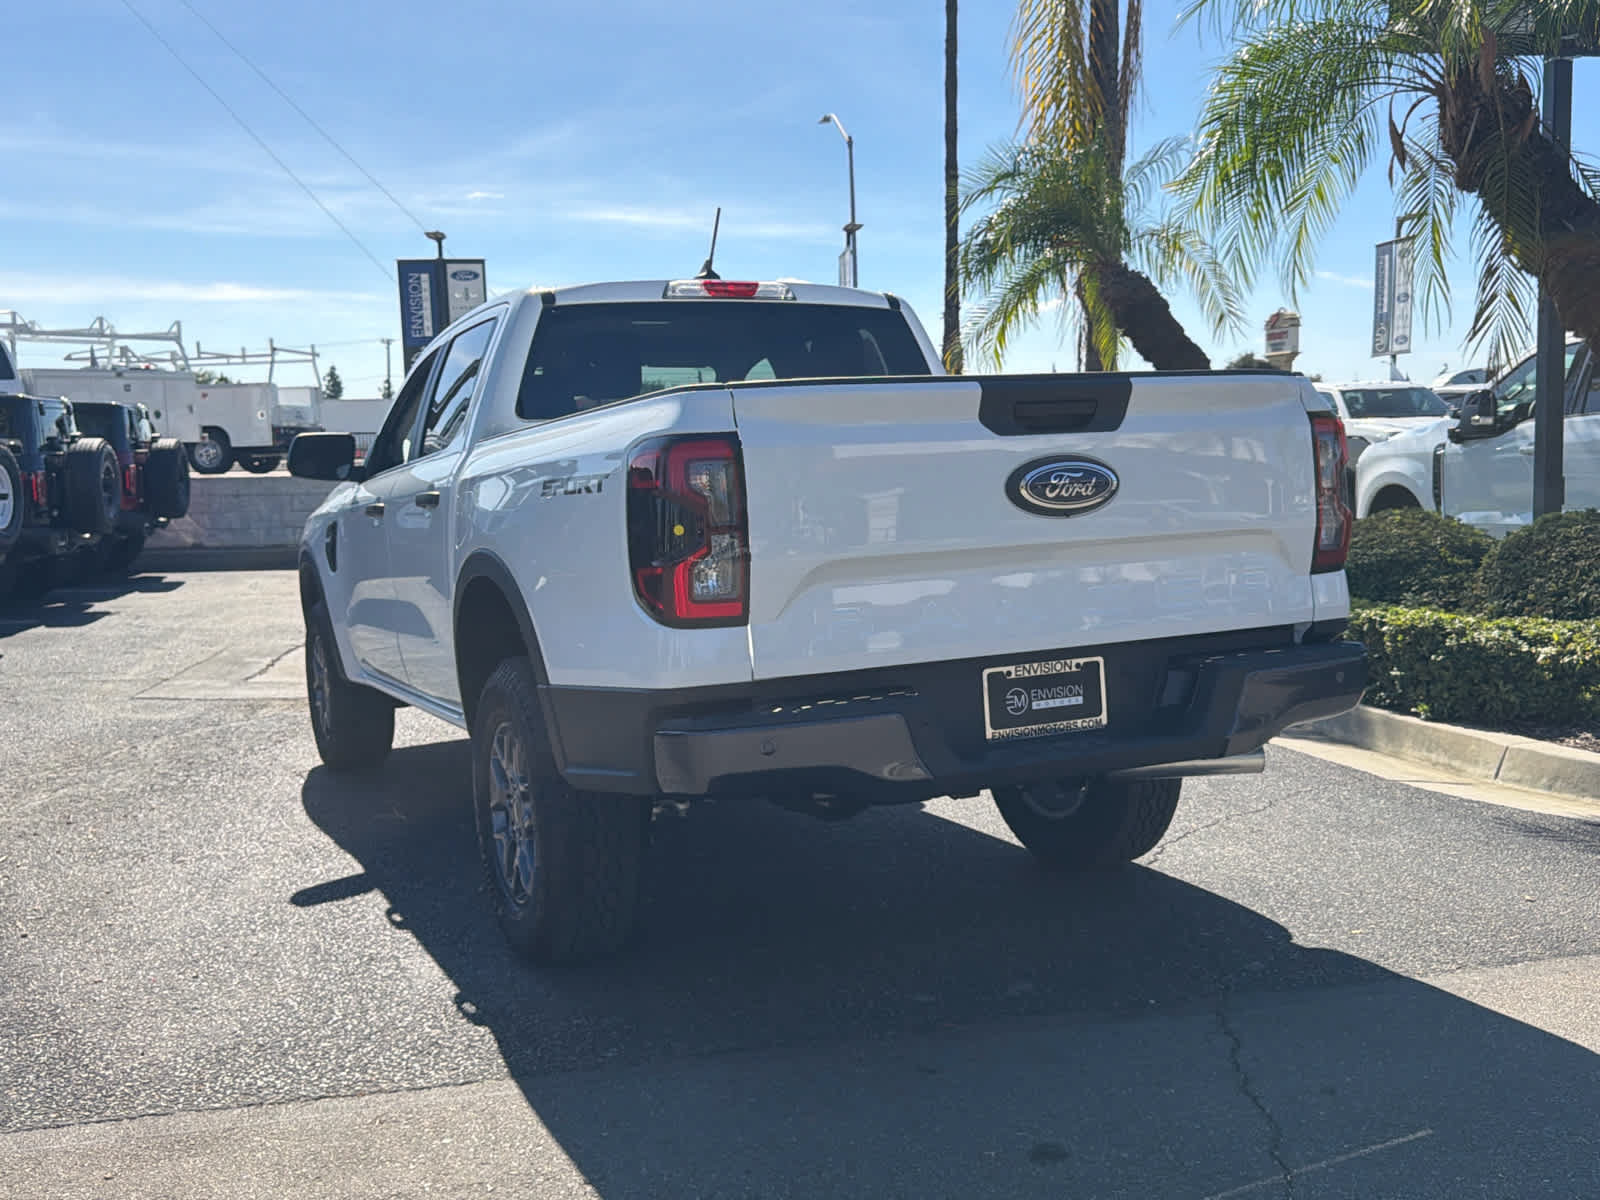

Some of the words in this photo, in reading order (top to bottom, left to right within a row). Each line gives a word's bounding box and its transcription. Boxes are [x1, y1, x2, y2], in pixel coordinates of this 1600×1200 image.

[408, 272, 425, 337] ENVISION
[1044, 471, 1096, 498] Ford
[1014, 660, 1073, 677] ENVISION
[1031, 684, 1083, 701] ENVISION
[991, 718, 1102, 740] ENVISIONMOTORS.COM
